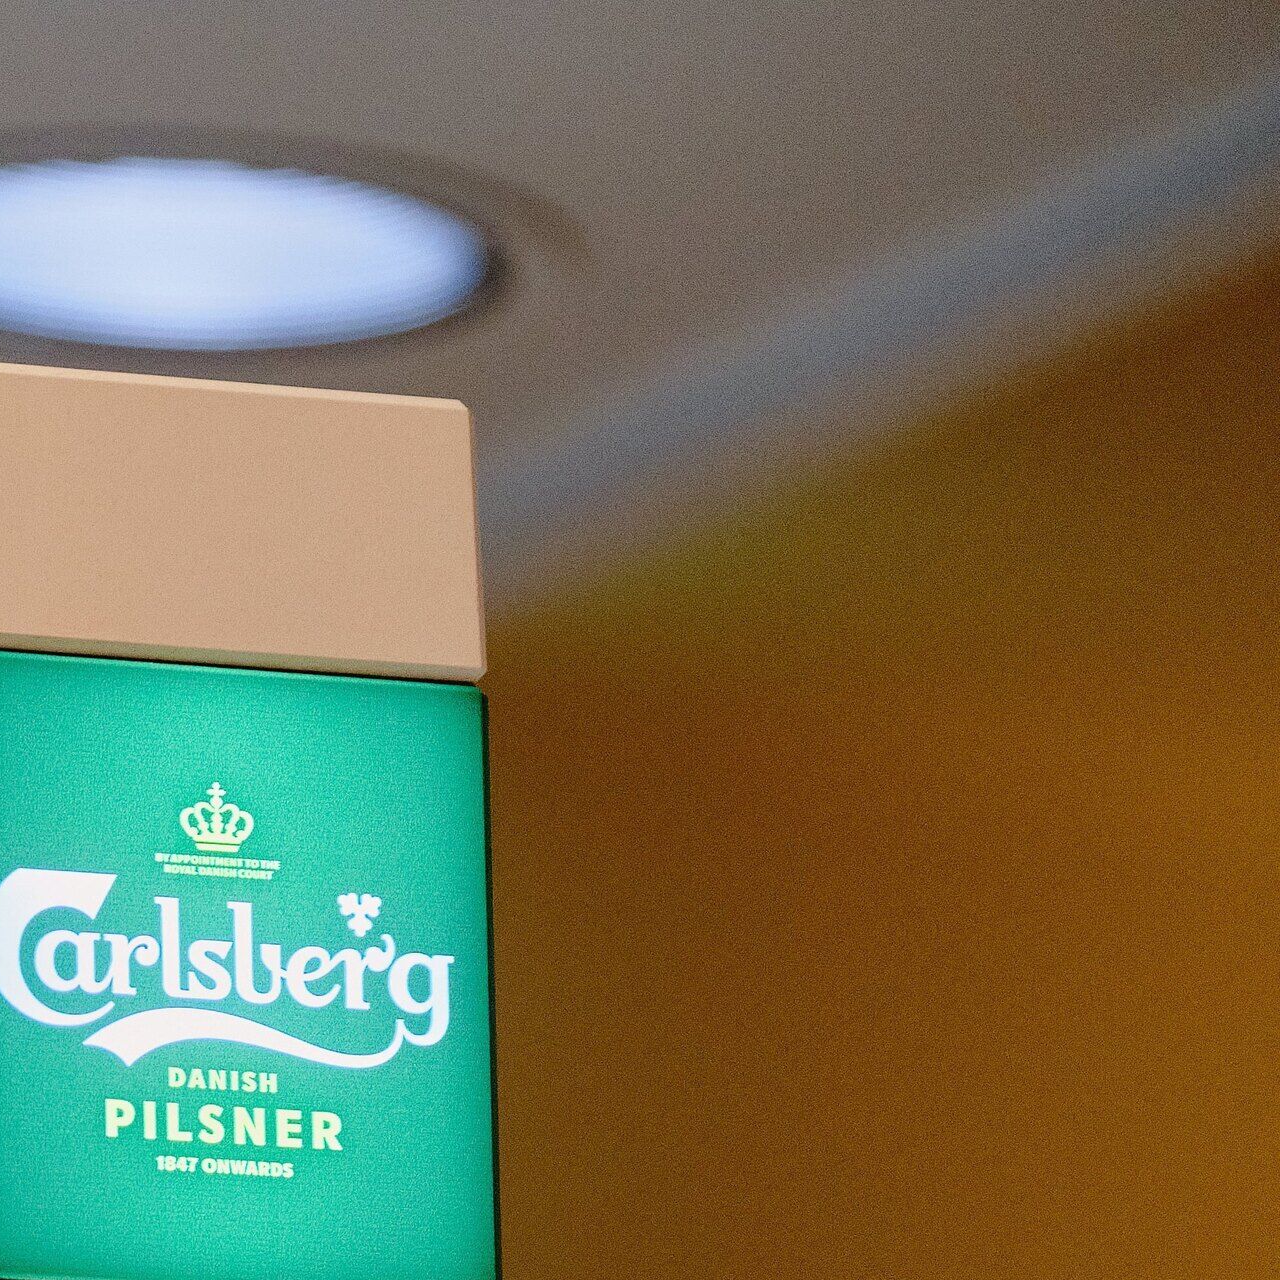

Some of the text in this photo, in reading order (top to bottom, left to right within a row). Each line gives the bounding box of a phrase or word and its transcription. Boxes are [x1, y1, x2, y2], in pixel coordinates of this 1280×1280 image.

[167, 1066, 278, 1094] DANISH
[104, 1097, 344, 1151] PILSNER
[155, 1155, 295, 1179] 1847 ONWARDS
